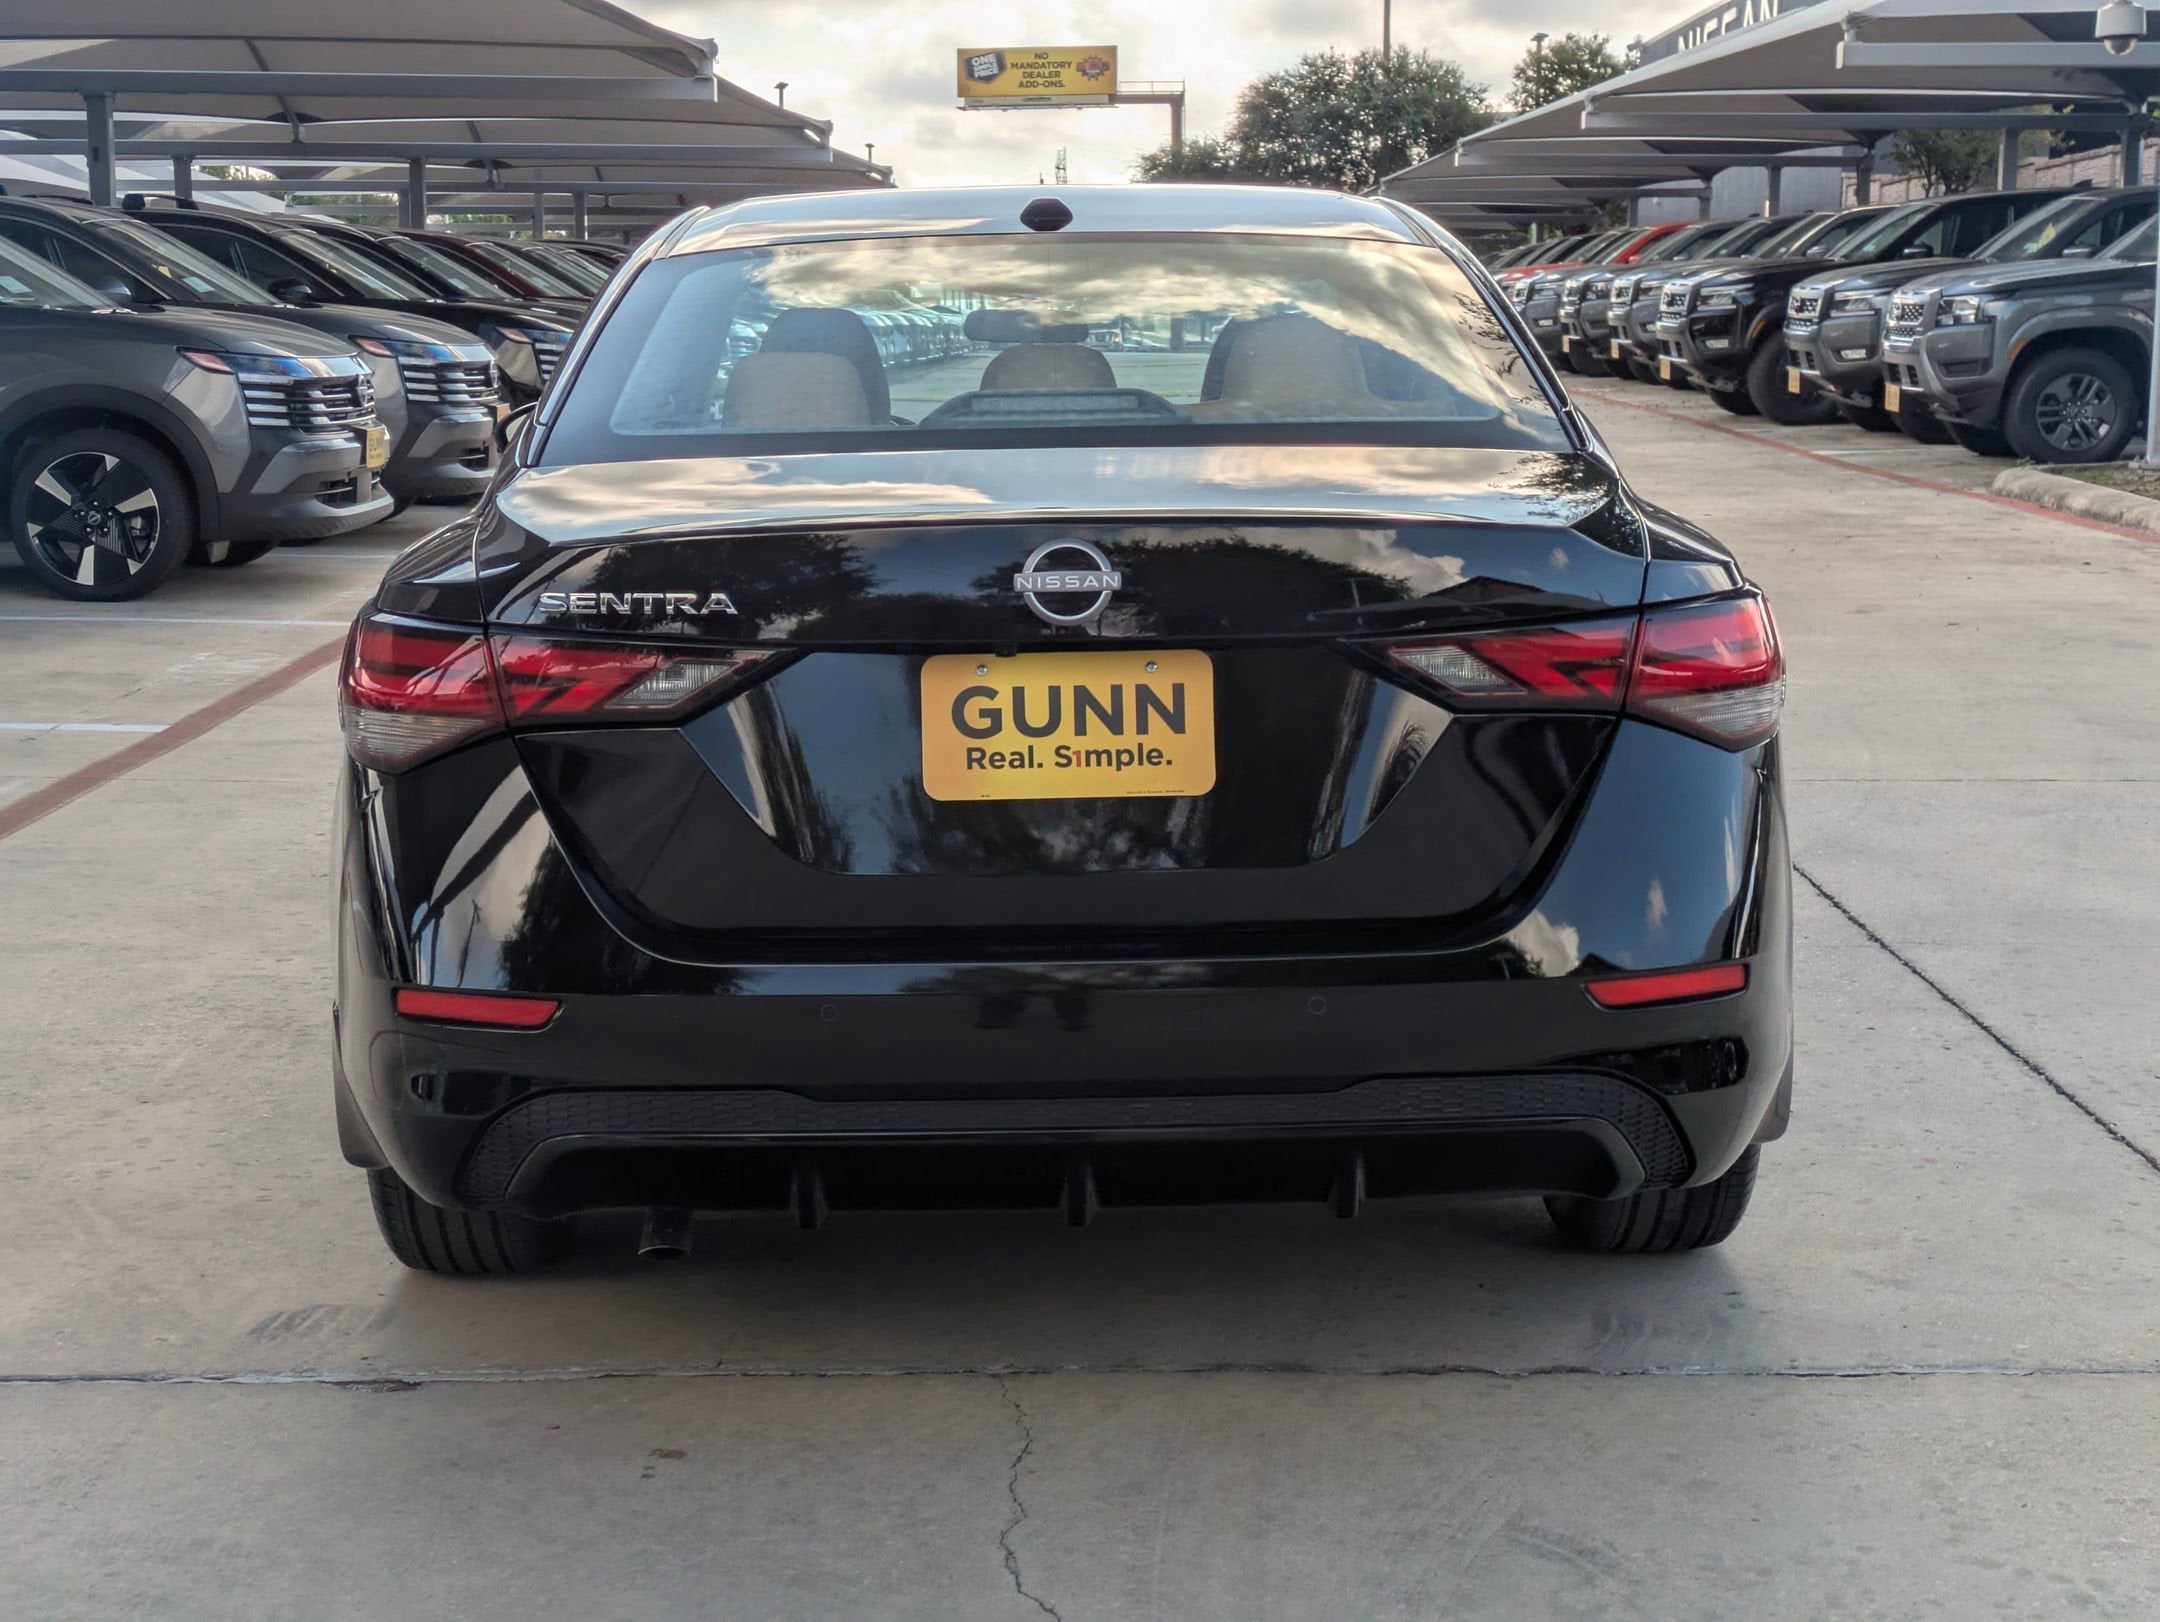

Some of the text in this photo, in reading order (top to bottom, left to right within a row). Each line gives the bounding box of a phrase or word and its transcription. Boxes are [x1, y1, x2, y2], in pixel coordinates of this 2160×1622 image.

[971, 53, 997, 66] ONE
[1034, 52, 1049, 60] NO
[1010, 61, 1073, 70] MANDATORY
[1022, 71, 1061, 79] DEALER
[1018, 80, 1066, 88] ADD-ONS.
[1016, 574, 1119, 589] NISSAN
[539, 592, 739, 615] SENTRA
[951, 682, 1187, 740] GUNN
[966, 745, 1044, 770] Real.
